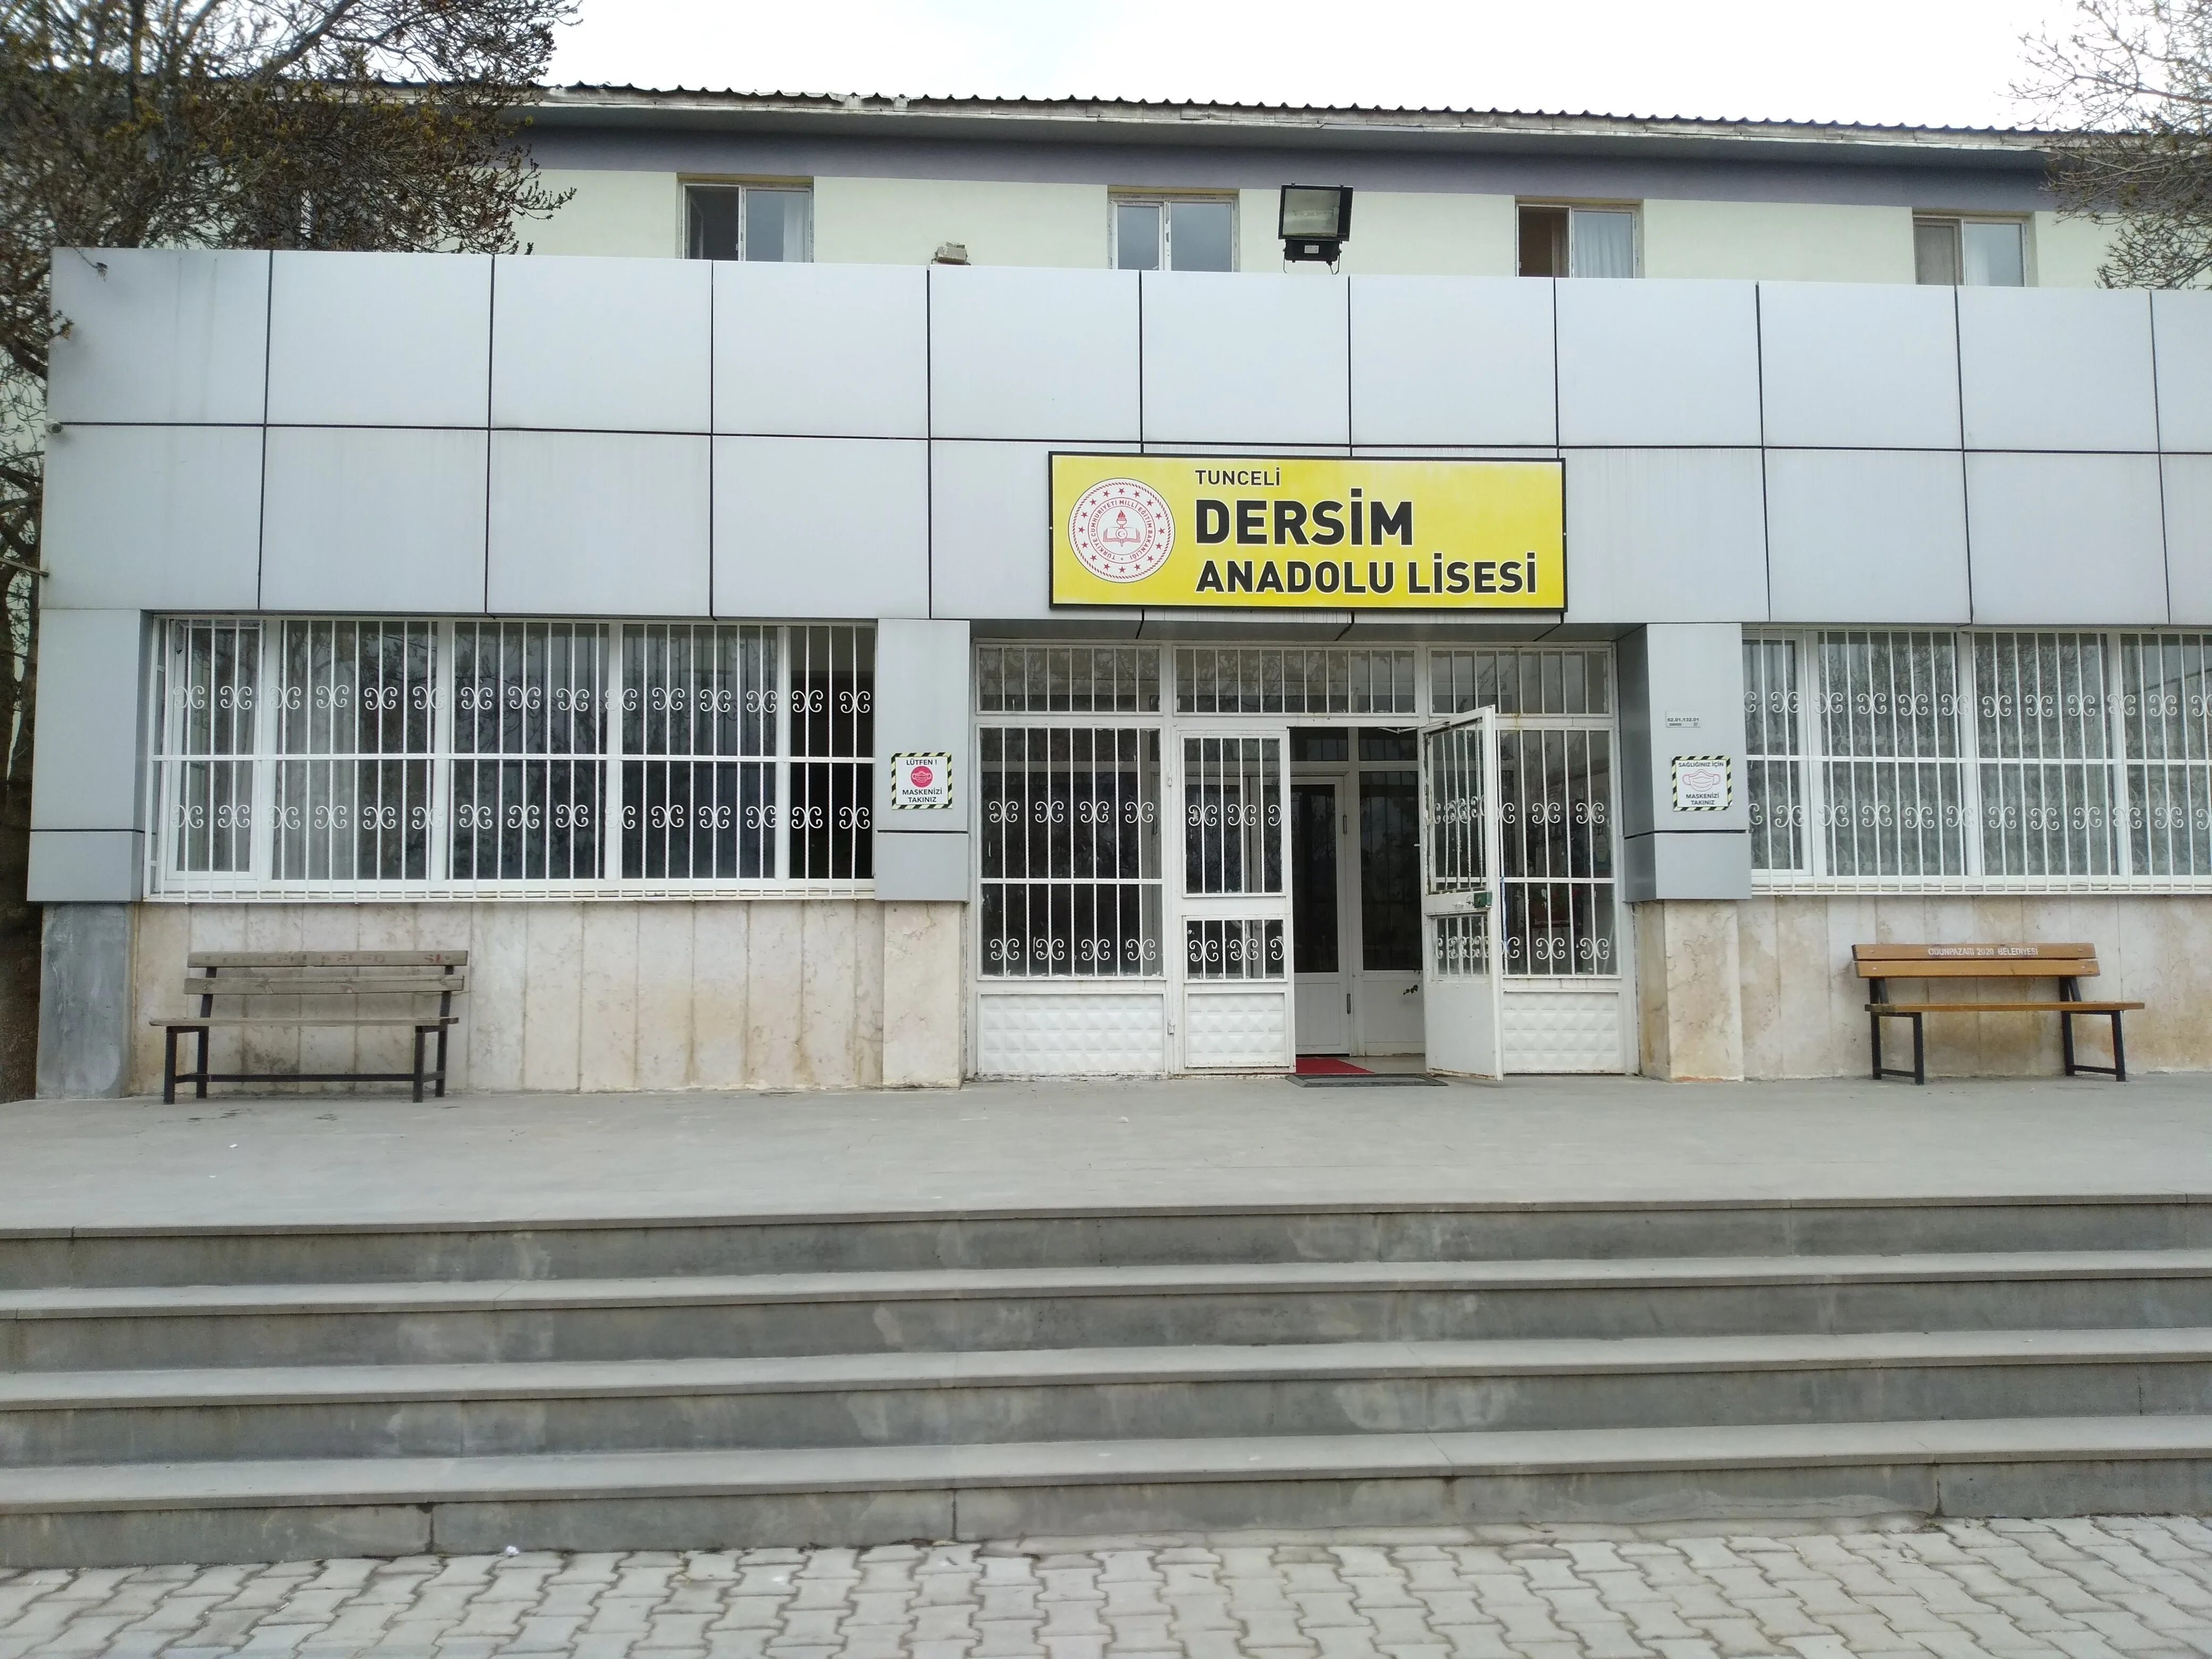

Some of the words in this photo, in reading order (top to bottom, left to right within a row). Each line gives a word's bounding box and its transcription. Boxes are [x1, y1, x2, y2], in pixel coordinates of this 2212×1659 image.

[1195, 467, 1280, 486] TUNCELİ
[1091, 499, 1117, 537] CUMHURİYETİ
[1138, 507, 1153, 528] EĞİTİM
[1195, 488, 1413, 546] DERSİM
[1129, 530, 1153, 560] BAKANLIĞI
[1196, 560, 1394, 593] ANADOLU
[1409, 552, 1536, 594] LİSESİ
